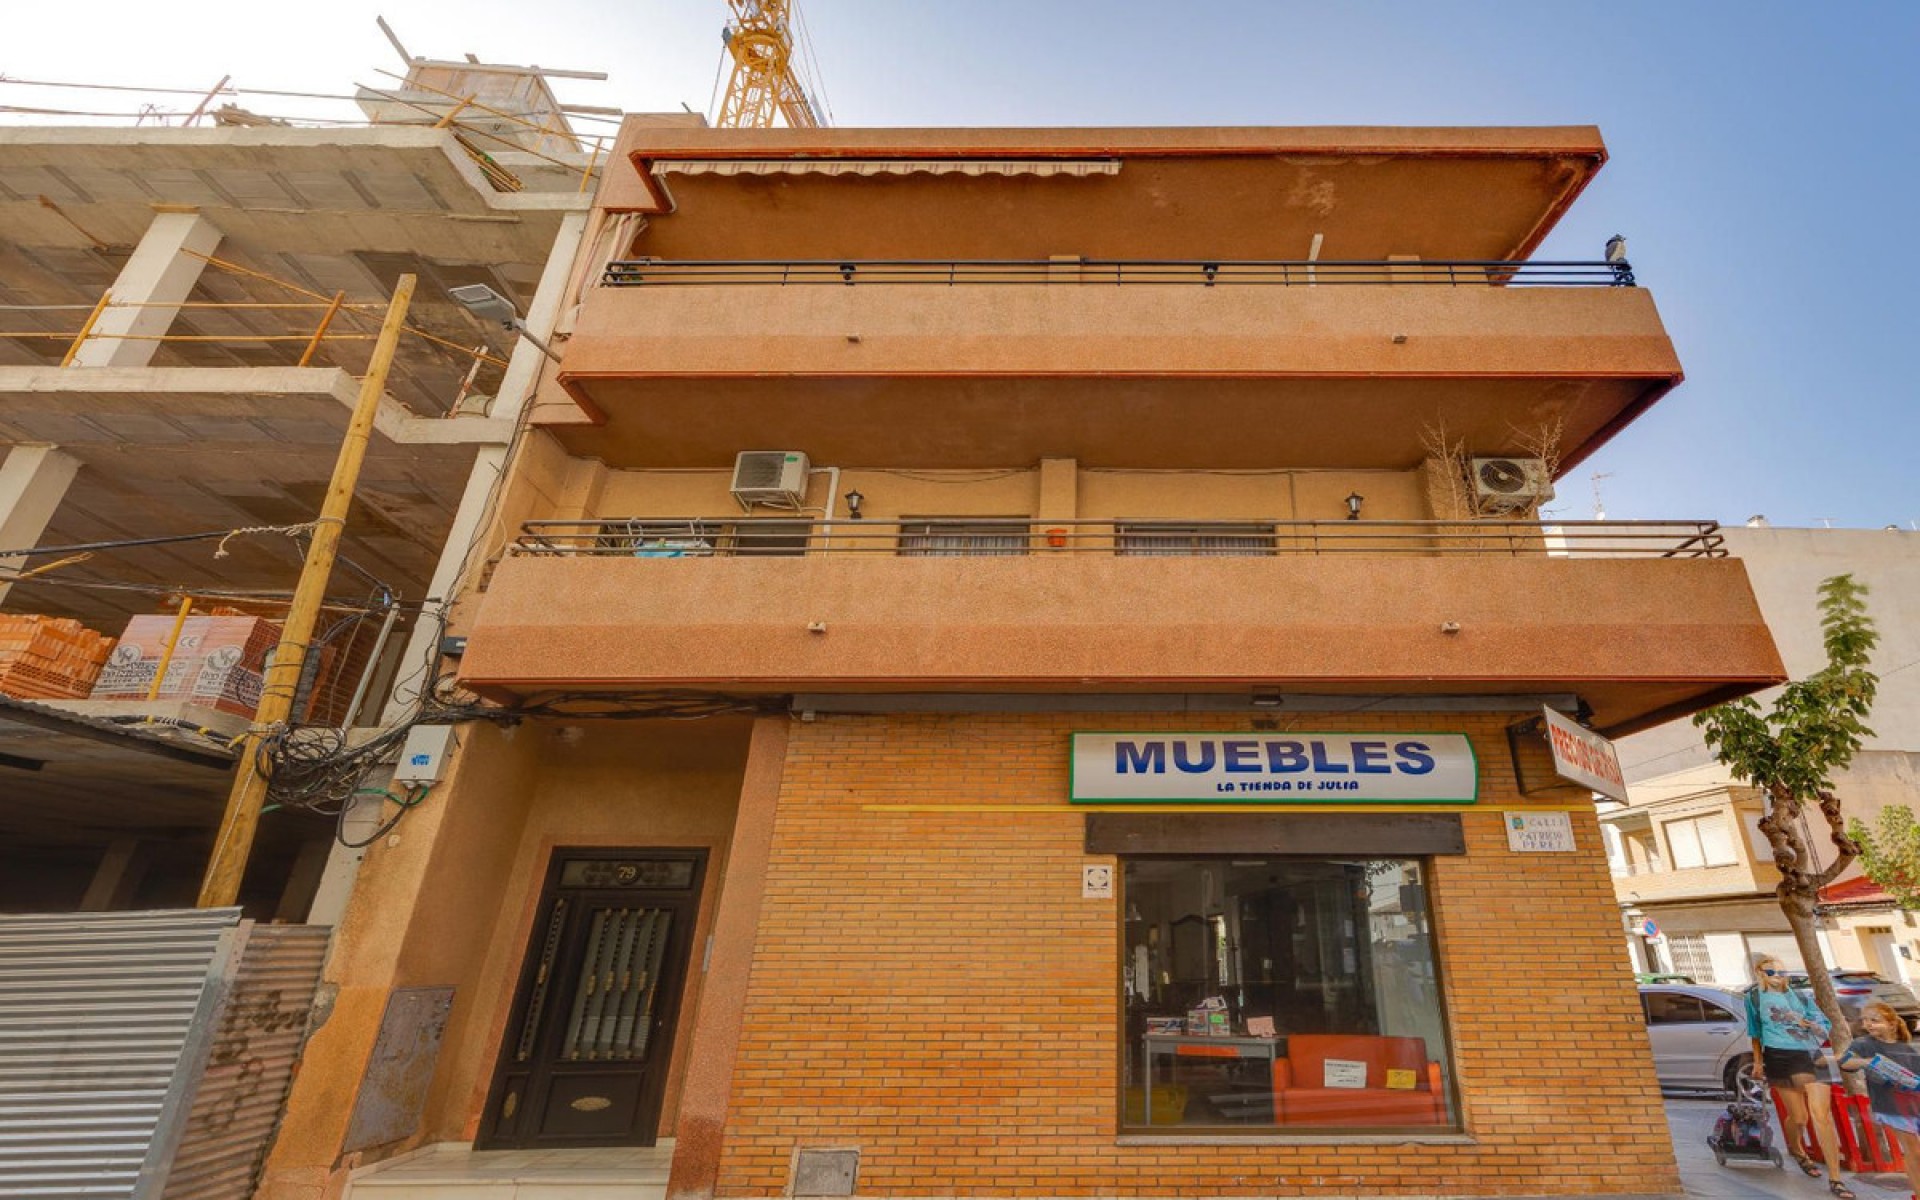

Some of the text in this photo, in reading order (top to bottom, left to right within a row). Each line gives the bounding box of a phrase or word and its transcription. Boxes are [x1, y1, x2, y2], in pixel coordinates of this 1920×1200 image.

[1115, 740, 1436, 775] MUEBLES
[1217, 780, 1359, 792] LA TIENDA DE JULIA
[620, 866, 636, 879] 79
